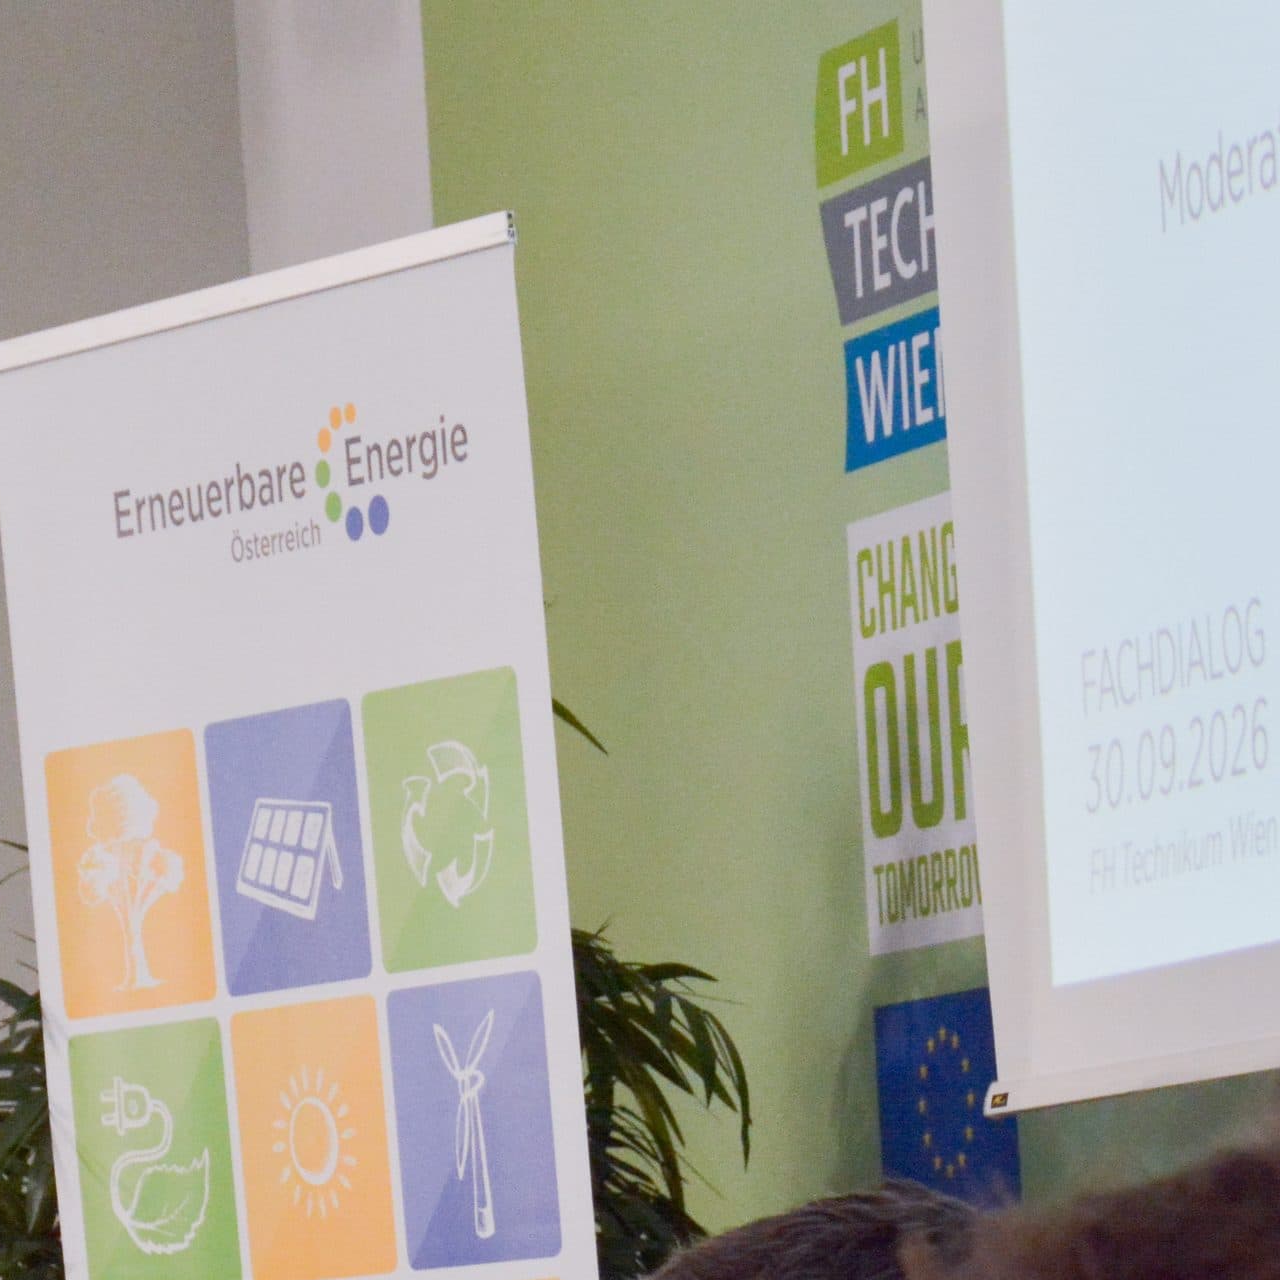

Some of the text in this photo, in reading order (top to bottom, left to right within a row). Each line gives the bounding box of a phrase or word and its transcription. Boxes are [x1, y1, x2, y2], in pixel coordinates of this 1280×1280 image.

[837, 46, 889, 155] FH
[112, 414, 469, 539] Erneuerbare Energie
[230, 519, 321, 563] Österreich
[1080, 597, 1265, 718] FACHDIALOG
[1086, 696, 1268, 814] 30.09.2026
[873, 843, 984, 928] TOMORRO
[1089, 809, 1278, 895] FH Technikum Wien
